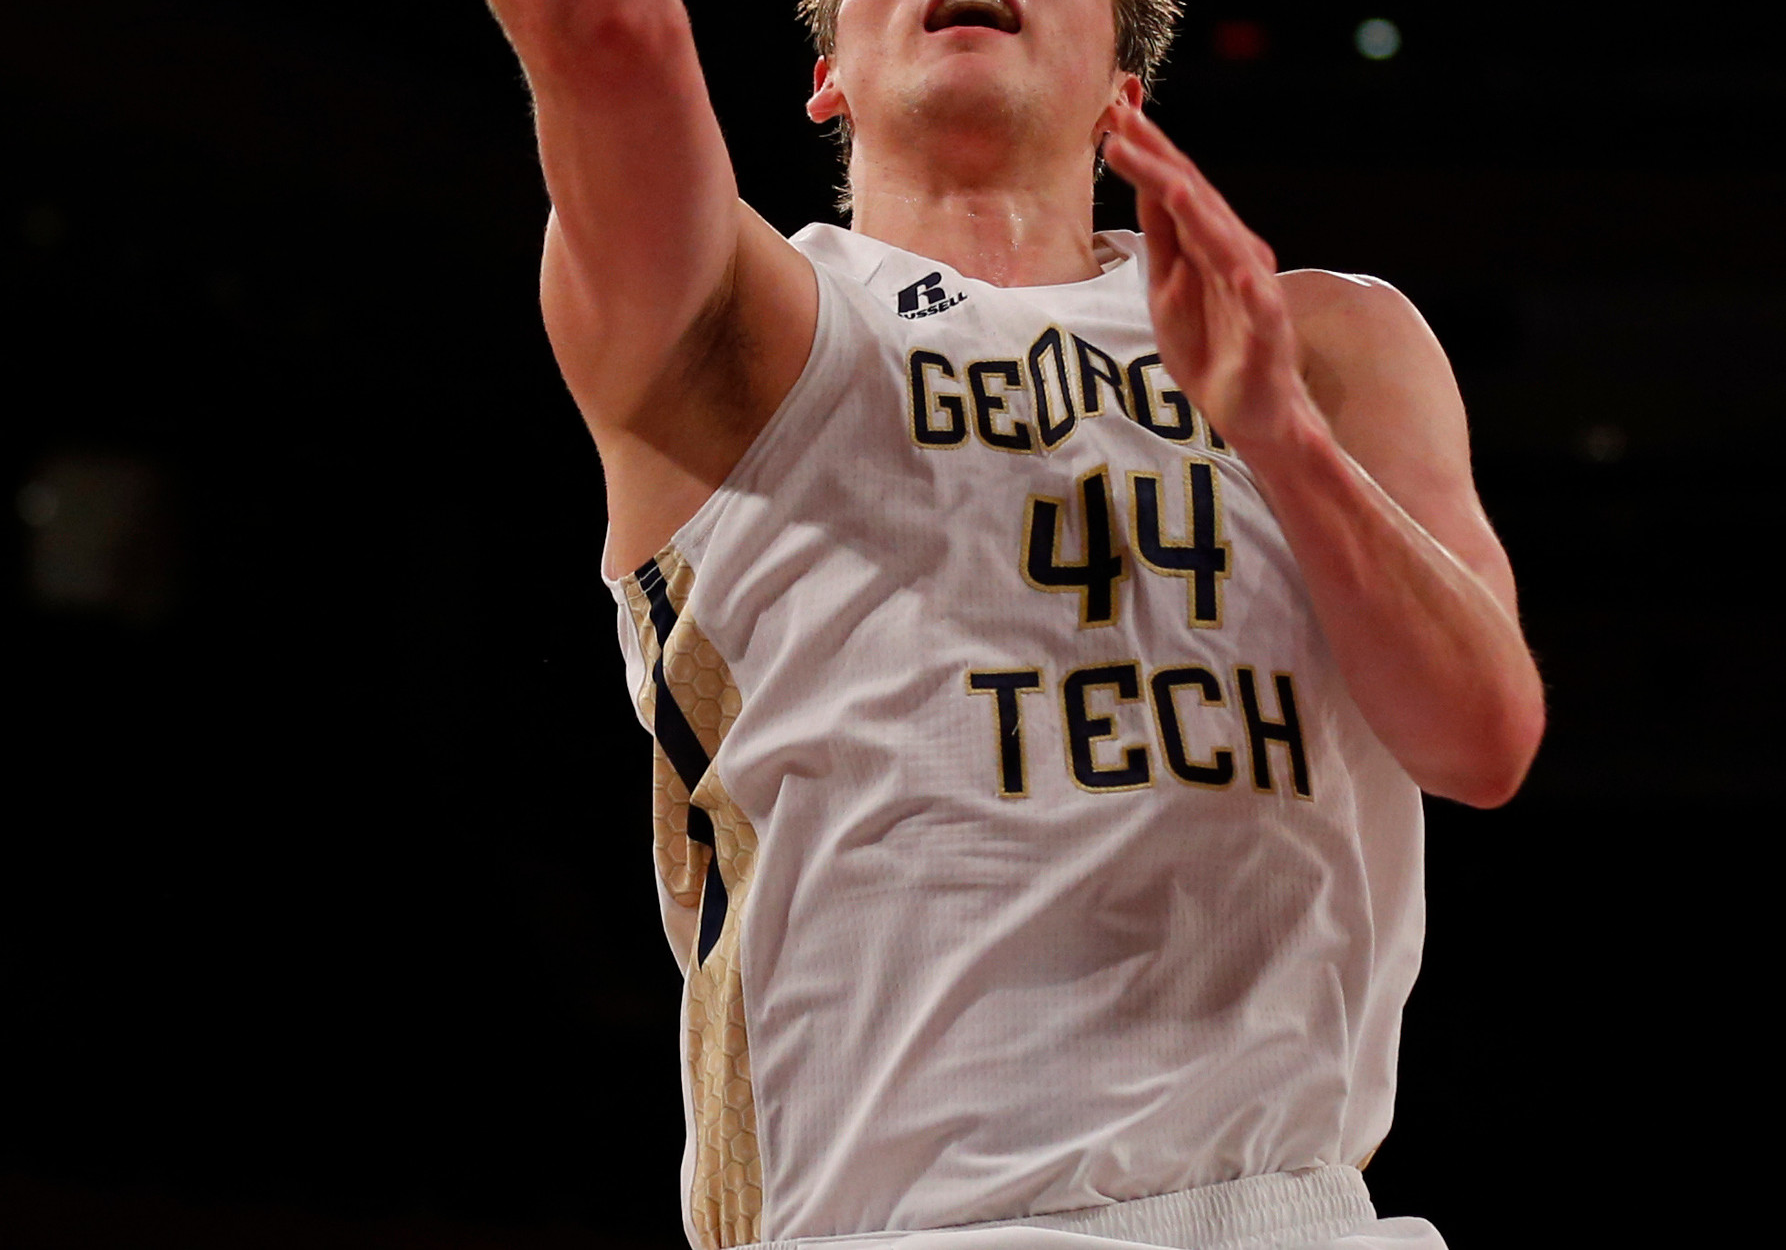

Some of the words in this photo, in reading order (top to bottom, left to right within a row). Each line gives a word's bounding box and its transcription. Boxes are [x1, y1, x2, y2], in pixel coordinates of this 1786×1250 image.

[906, 322, 1233, 457] GEORG
[1018, 456, 1232, 630] 44
[965, 658, 1315, 803] TECH
